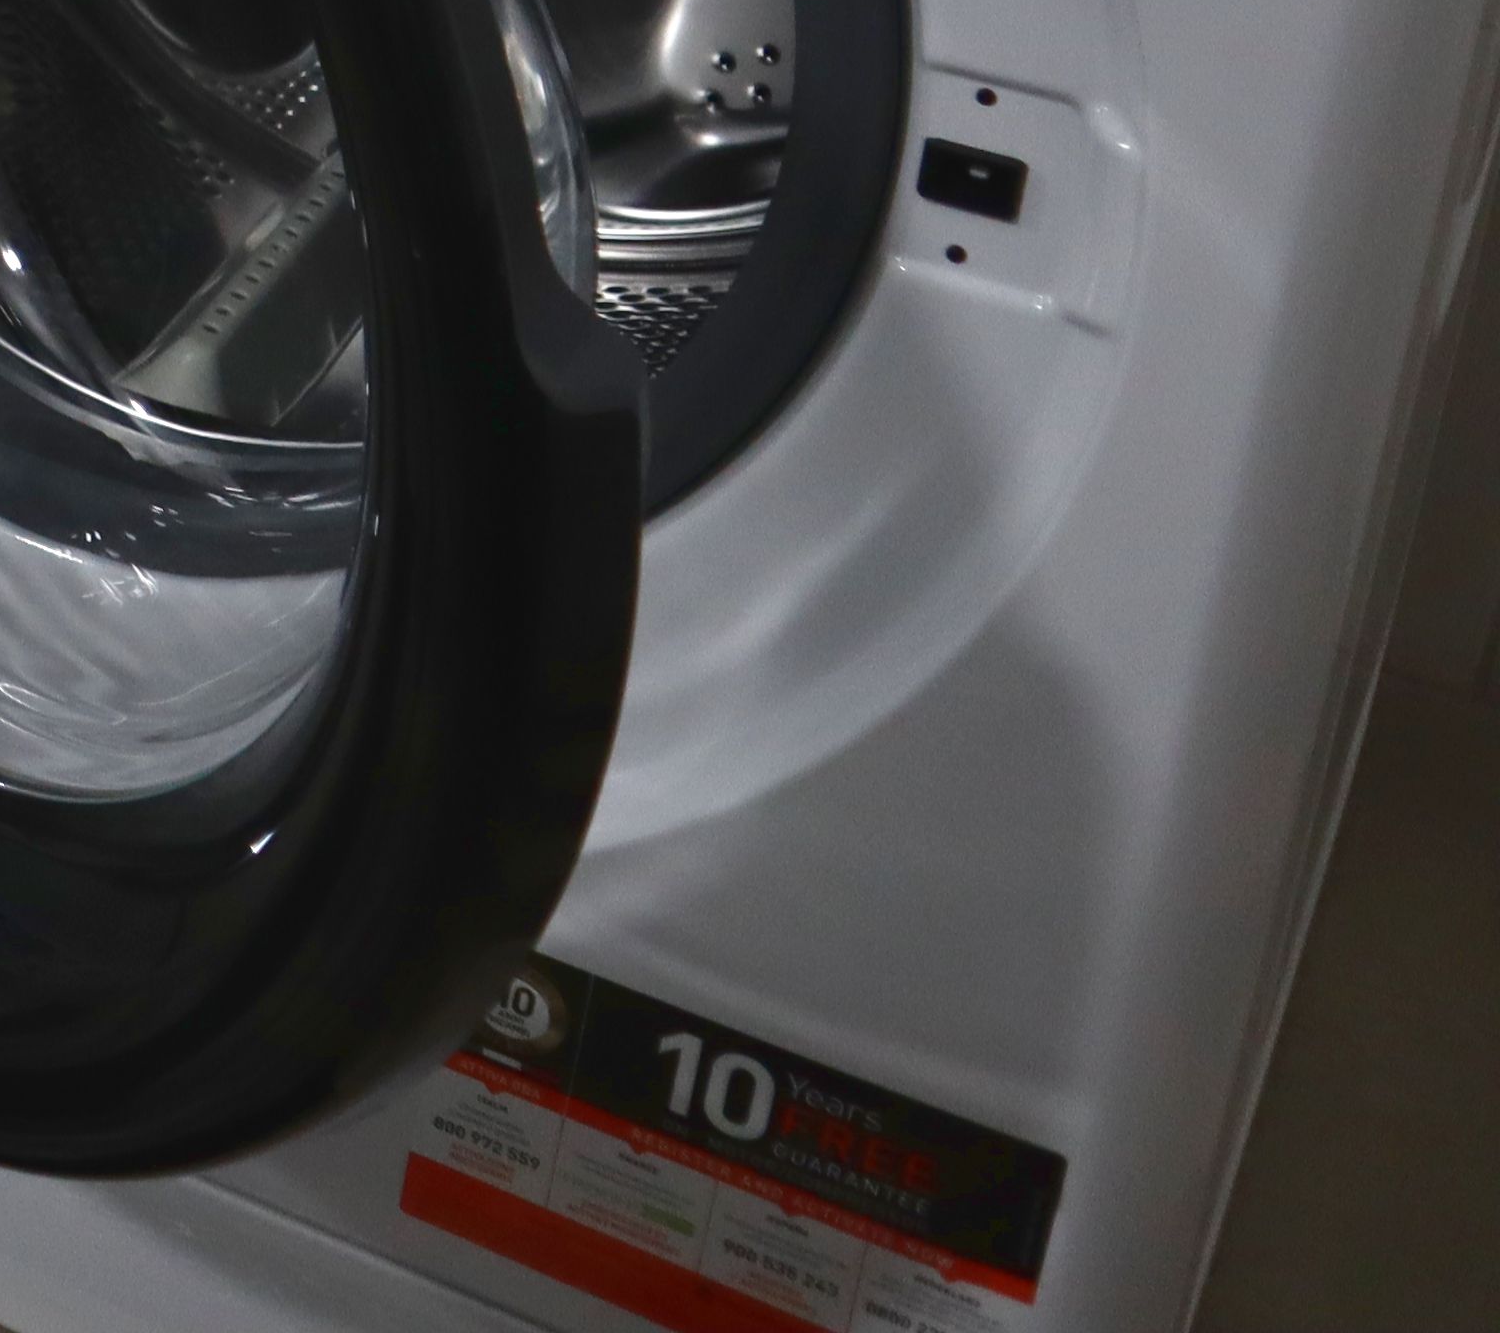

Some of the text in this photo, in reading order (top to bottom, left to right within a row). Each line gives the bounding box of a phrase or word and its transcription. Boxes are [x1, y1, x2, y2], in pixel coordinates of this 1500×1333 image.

[657, 1031, 777, 1142] 10
[788, 1071, 884, 1134] Years
[432, 1115, 466, 1140] 800
[470, 1130, 503, 1155] 972
[777, 1102, 940, 1194] FREE
[771, 1140, 934, 1216] GUARANTEE
